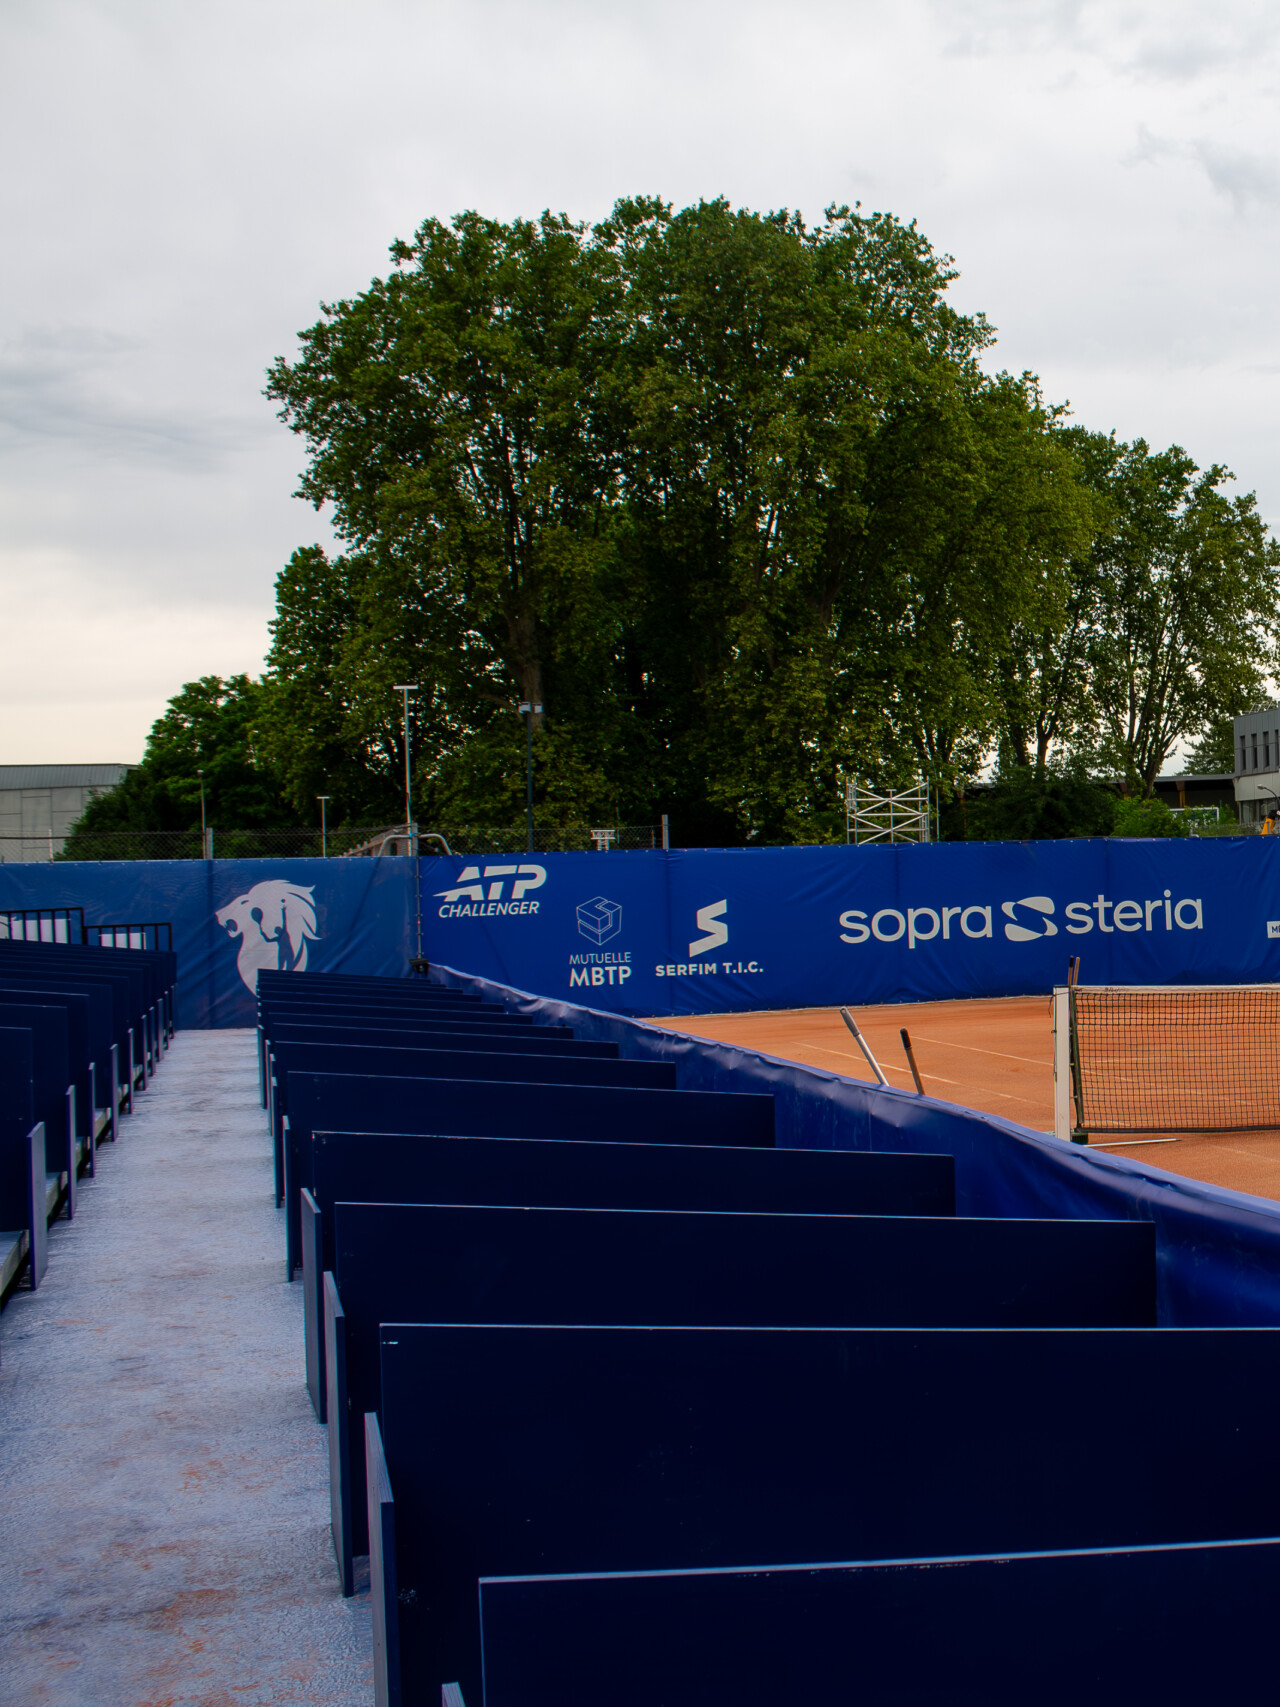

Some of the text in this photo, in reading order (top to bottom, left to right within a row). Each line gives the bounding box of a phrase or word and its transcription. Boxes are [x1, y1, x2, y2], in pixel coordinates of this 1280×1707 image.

[433, 864, 547, 902] ATP
[438, 901, 540, 919] CHALLENGER
[838, 888, 1203, 950] sopra steria
[568, 951, 632, 965] MUTUELLE
[568, 965, 633, 988] MBTP
[654, 961, 765, 977] SERFIM T.I.C.
